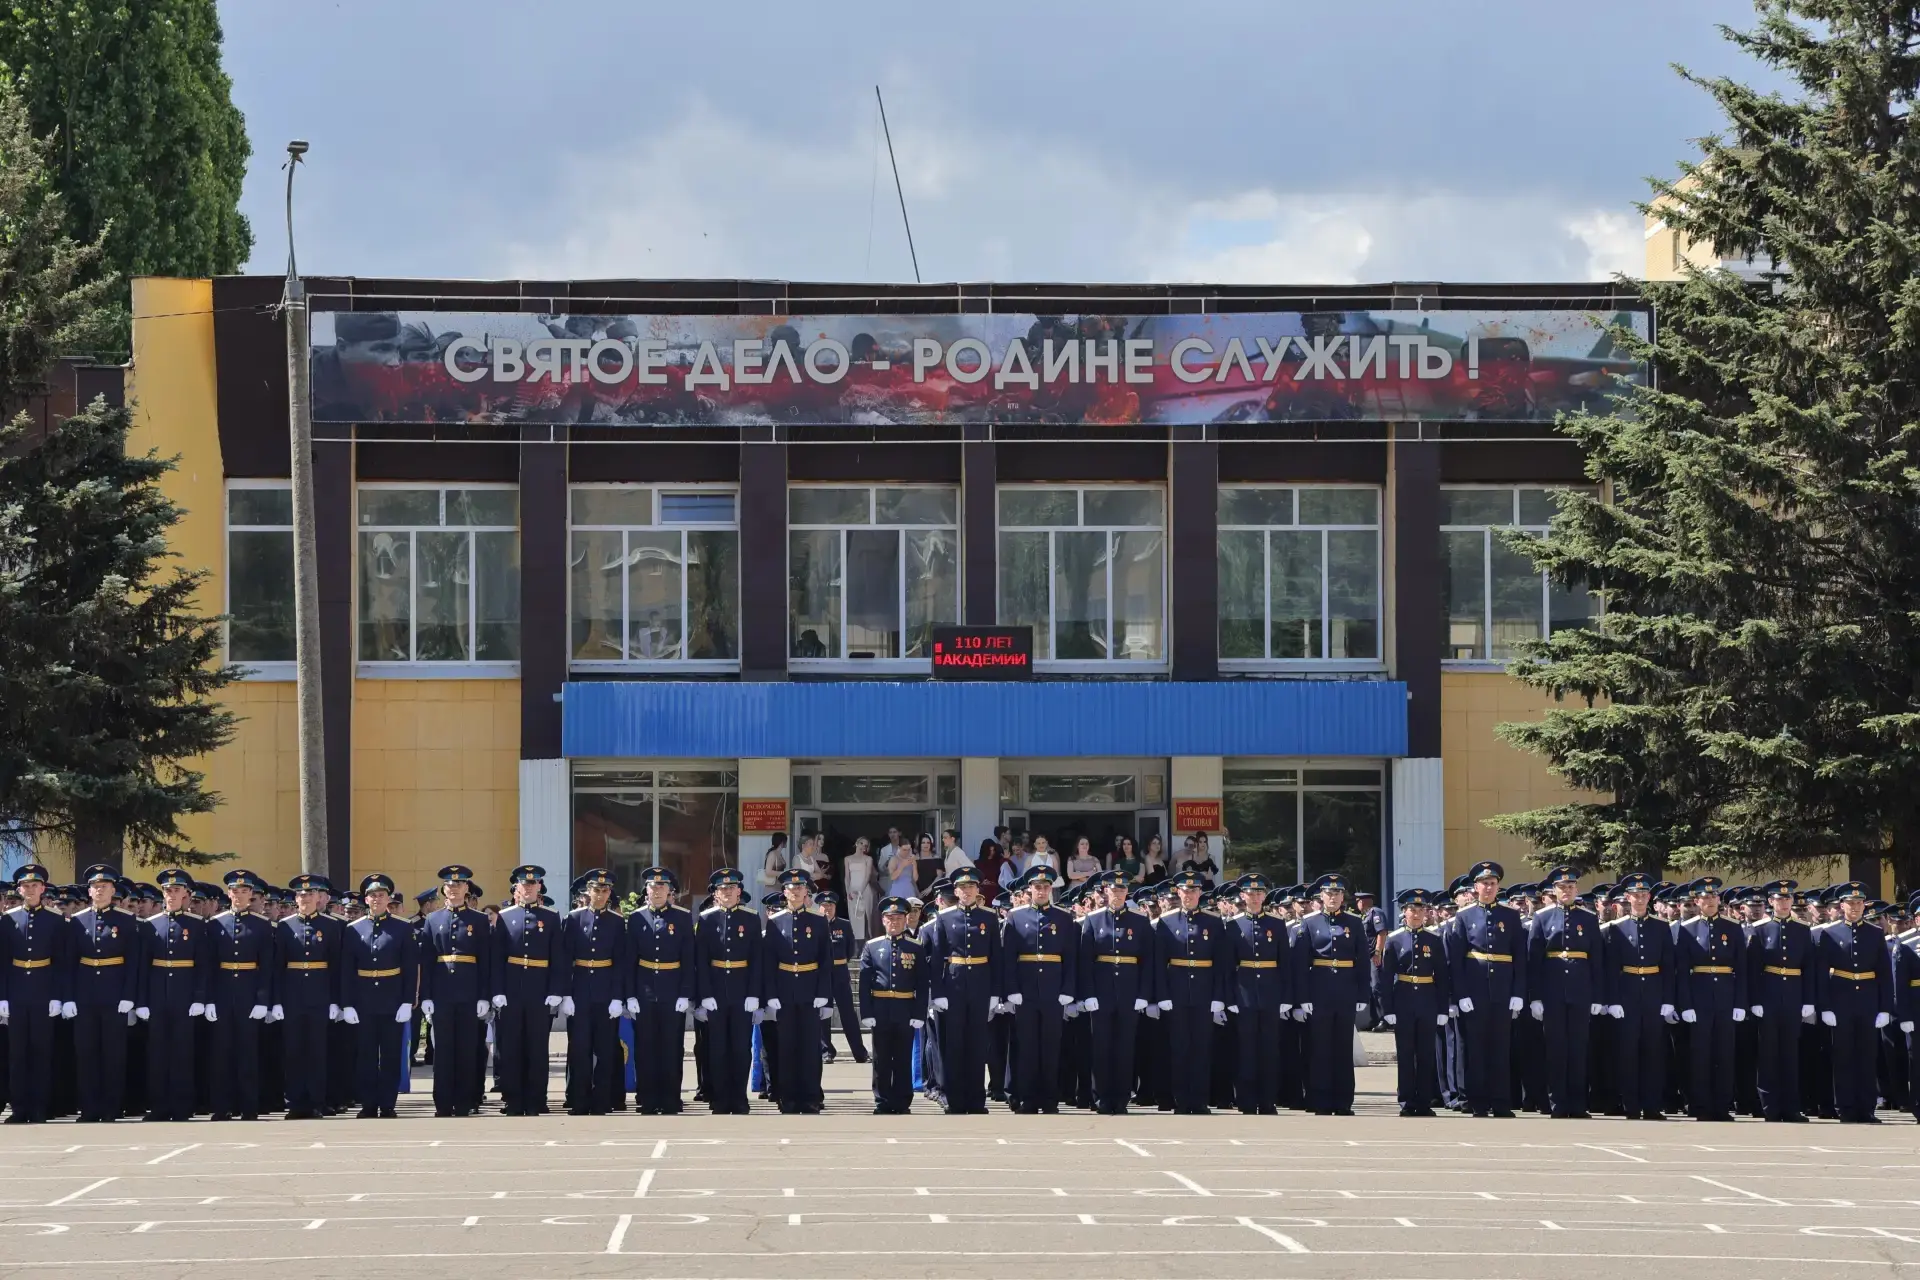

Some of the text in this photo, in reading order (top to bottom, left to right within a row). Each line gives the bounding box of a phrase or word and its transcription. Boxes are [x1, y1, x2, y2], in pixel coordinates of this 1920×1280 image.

[444, 338, 668, 384] СВЯТОЕ
[685, 338, 850, 391] ДЕЛО
[913, 337, 1154, 390] РОДИНЕ
[955, 636, 1013, 649] 110 ЛЕТ
[942, 653, 1027, 668] АКАДЕМИИ
[1178, 806, 1218, 816] КУРСАНТСКАЯ
[1183, 817, 1212, 827] СТОЛОВАЯ
